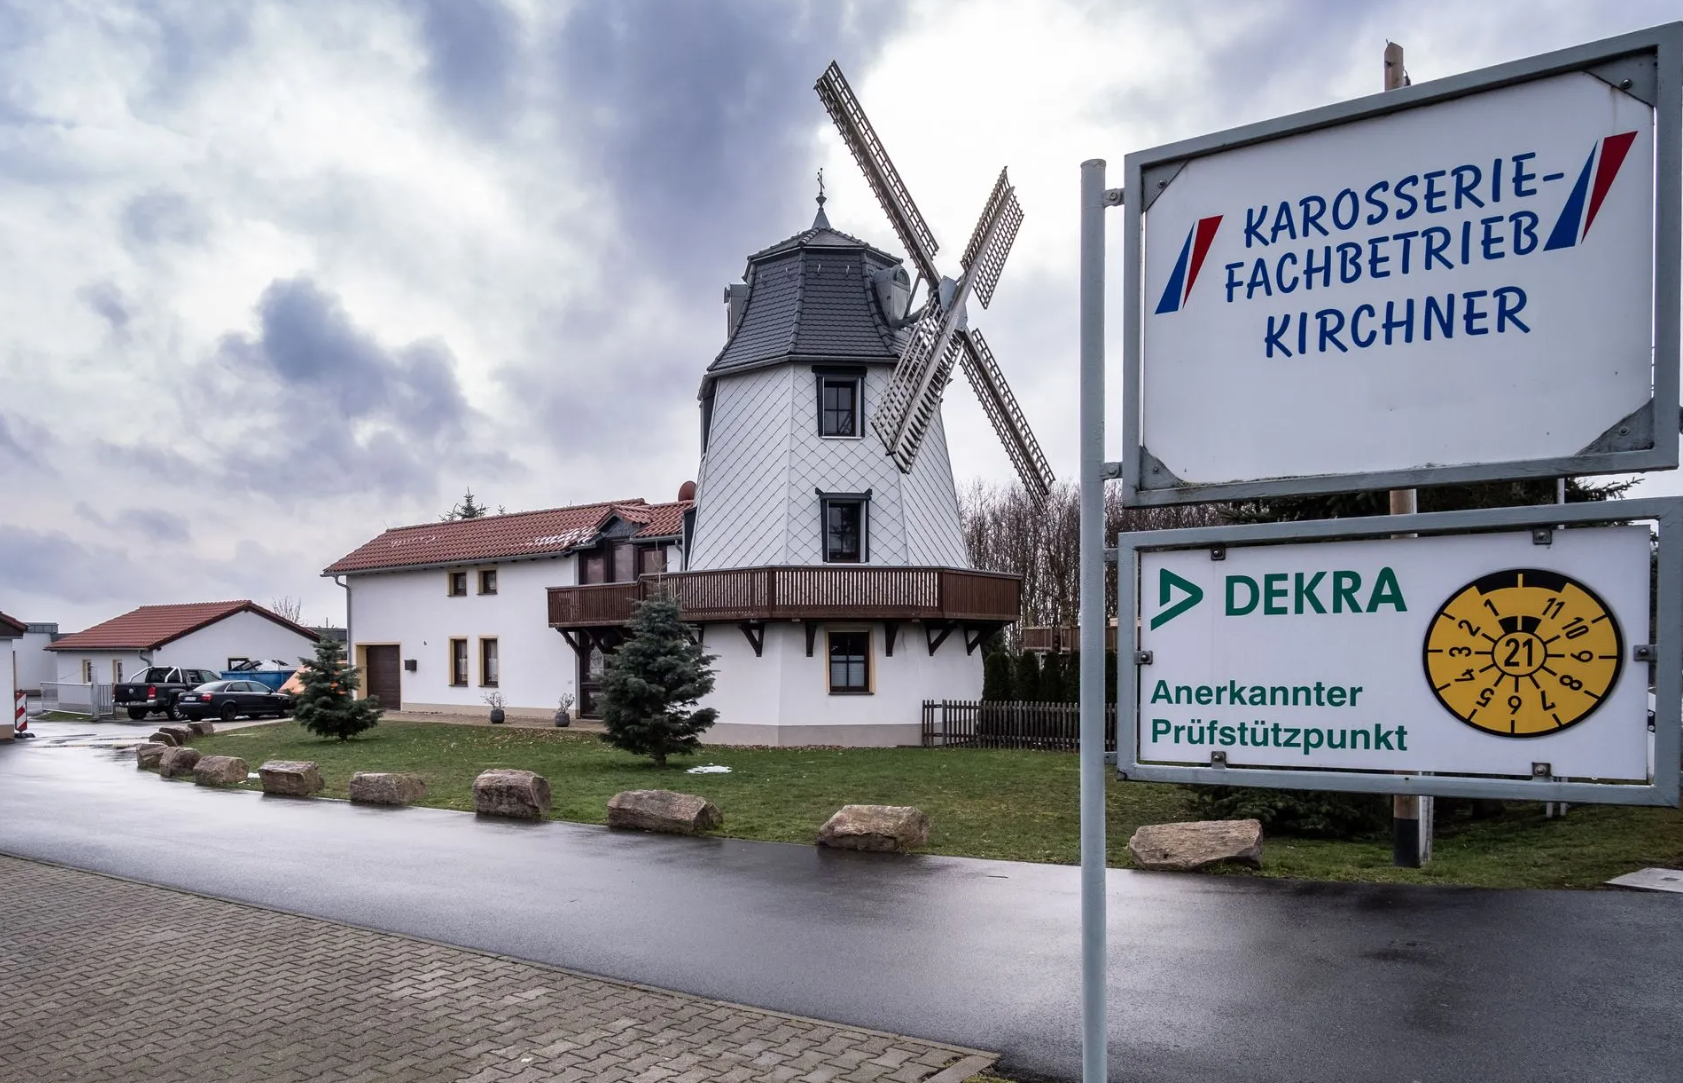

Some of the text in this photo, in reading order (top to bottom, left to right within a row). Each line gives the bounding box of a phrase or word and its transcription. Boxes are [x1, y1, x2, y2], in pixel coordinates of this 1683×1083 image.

[1243, 151, 1565, 249] KAROSSERIE-
[1225, 210, 1540, 303] FACHBETRIEB
[1264, 285, 1531, 359] KIRCHNER
[1225, 566, 1408, 617] DEKRA
[1483, 598, 1500, 617] 1
[1541, 597, 1566, 620] 11
[1457, 619, 1482, 638] 2
[1561, 616, 1590, 640] 10
[1448, 646, 1472, 658] 3
[1503, 637, 1534, 668] 21
[1454, 668, 1476, 683] 4
[1558, 674, 1584, 692] 8
[1150, 679, 1364, 708] Anerkannter
[1475, 687, 1495, 708] 5
[1540, 689, 1557, 712] 7
[1151, 718, 1408, 756] Prüfstützpunkt
